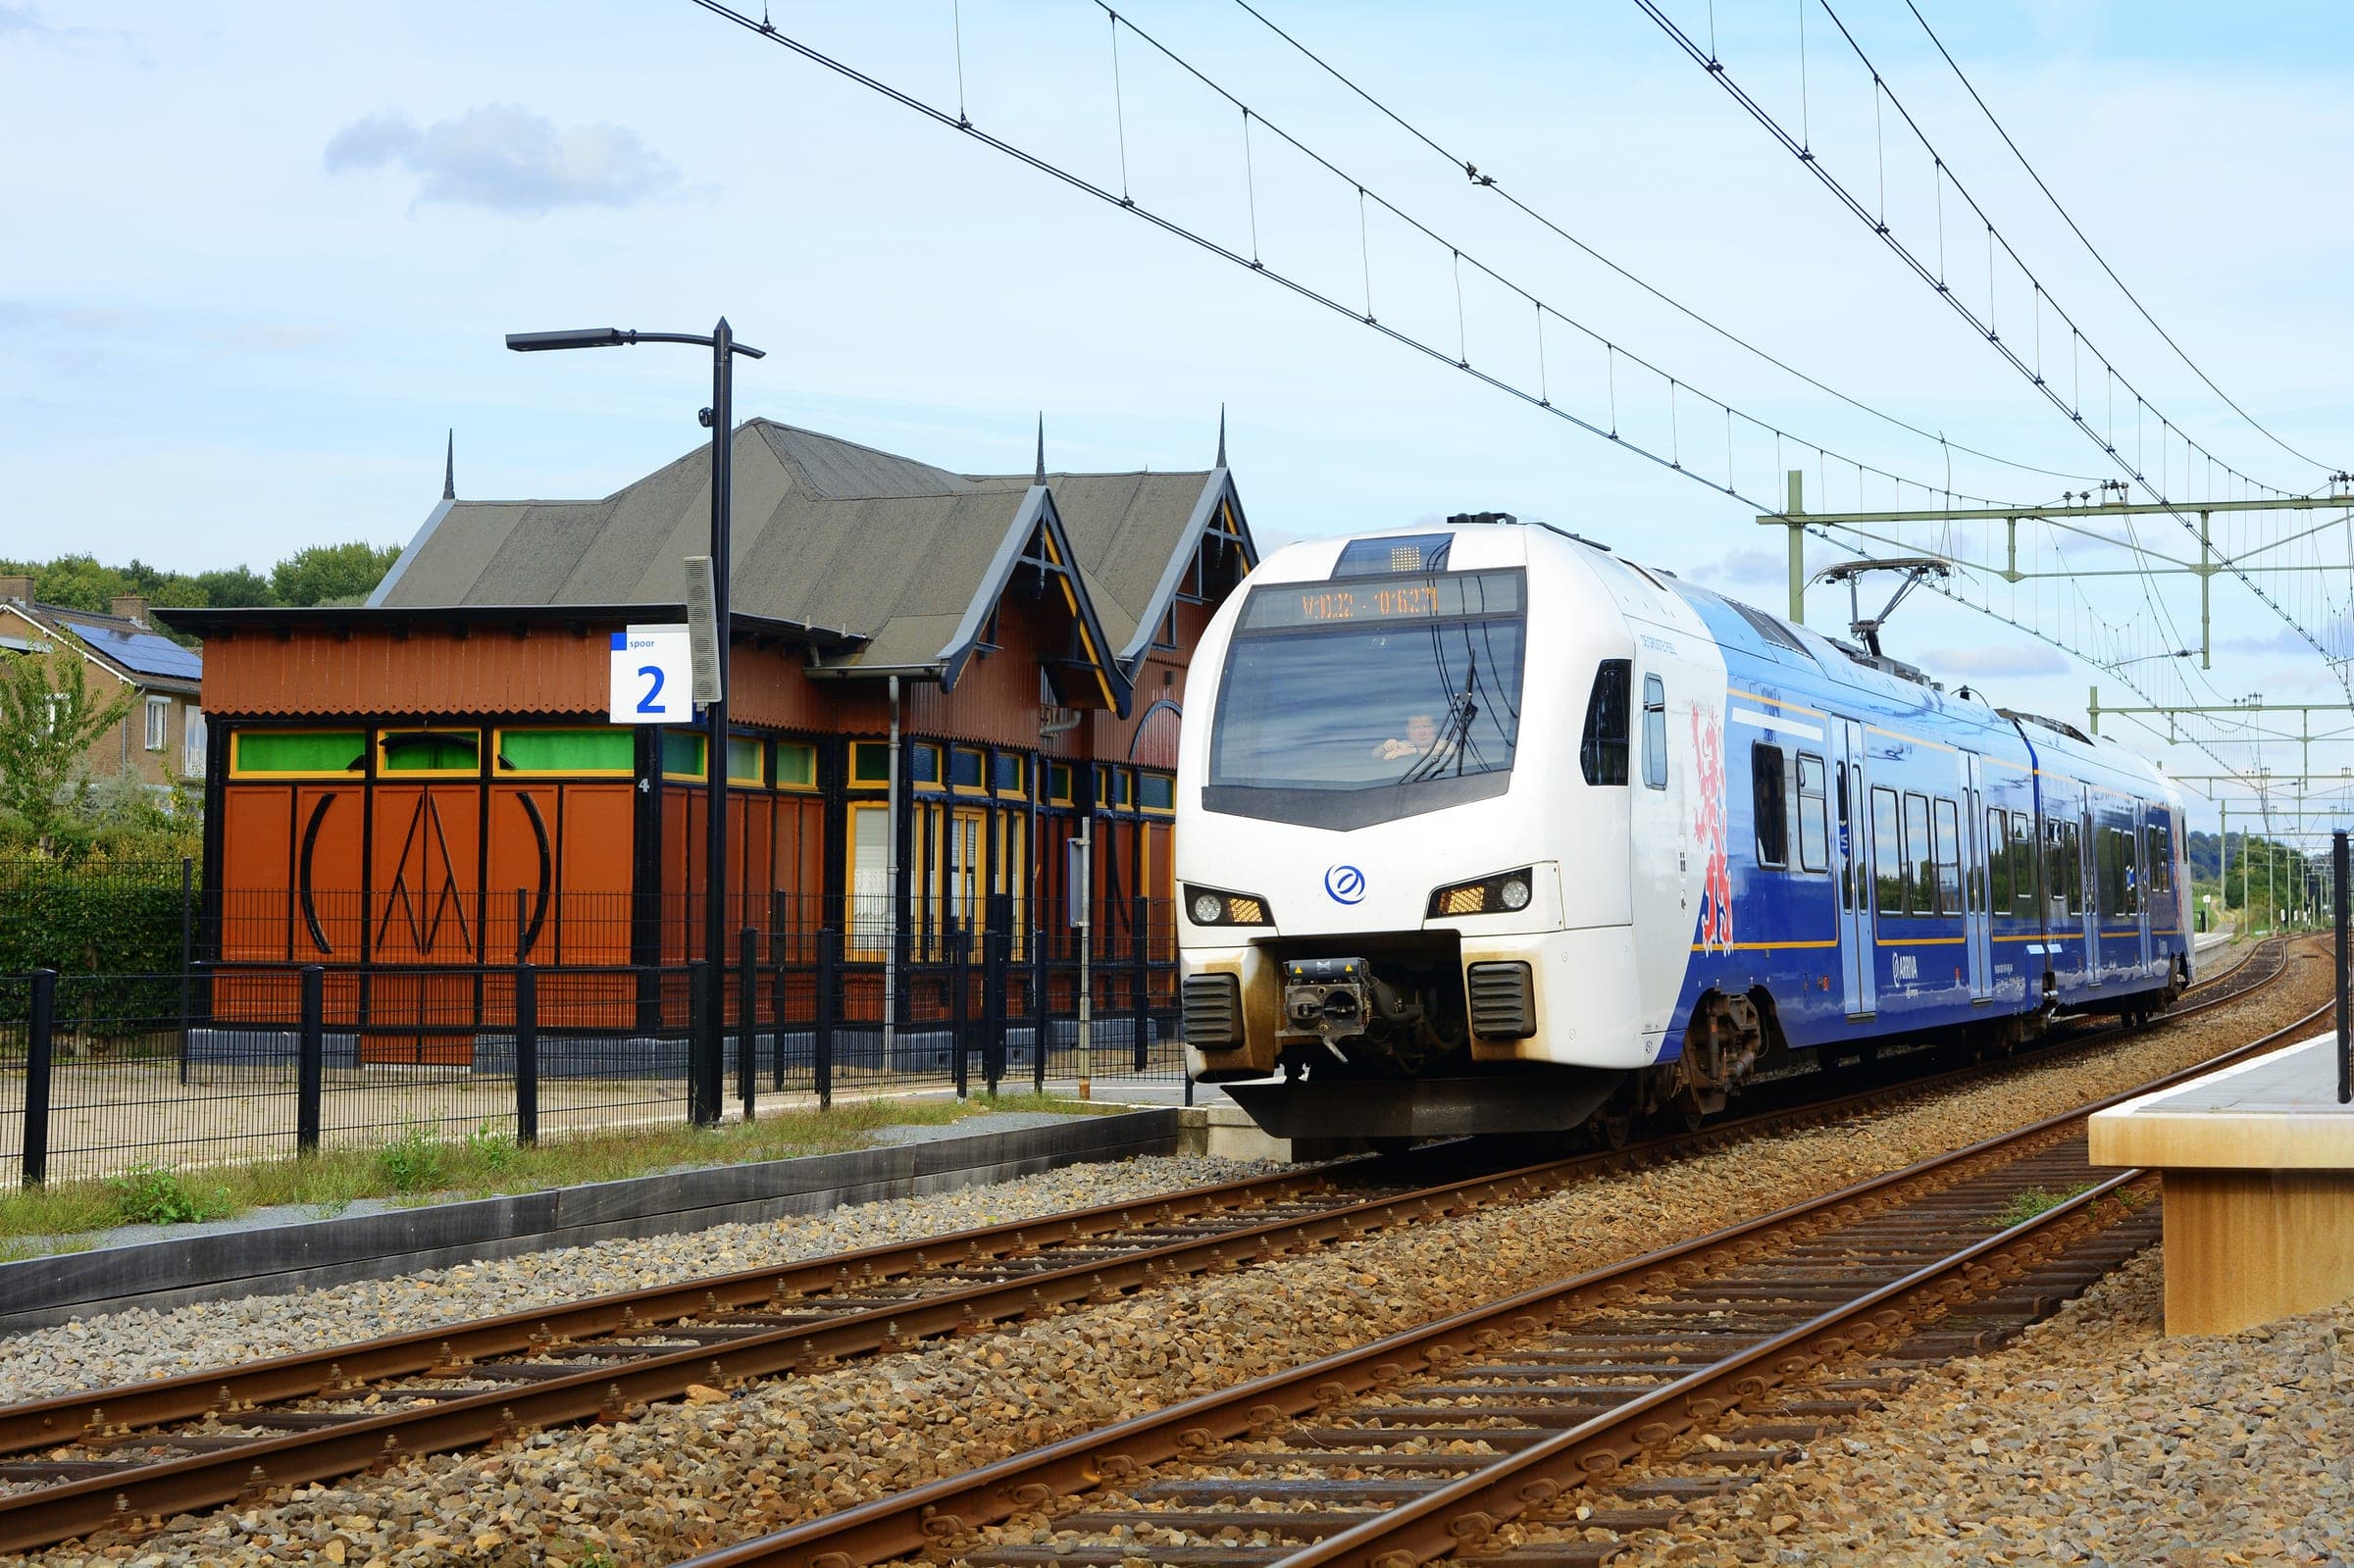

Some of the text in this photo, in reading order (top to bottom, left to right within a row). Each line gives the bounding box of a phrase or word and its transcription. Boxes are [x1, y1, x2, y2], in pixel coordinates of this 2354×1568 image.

[629, 639, 655, 649] spoor
[637, 665, 666, 714] 2
[639, 778, 650, 793] 4
